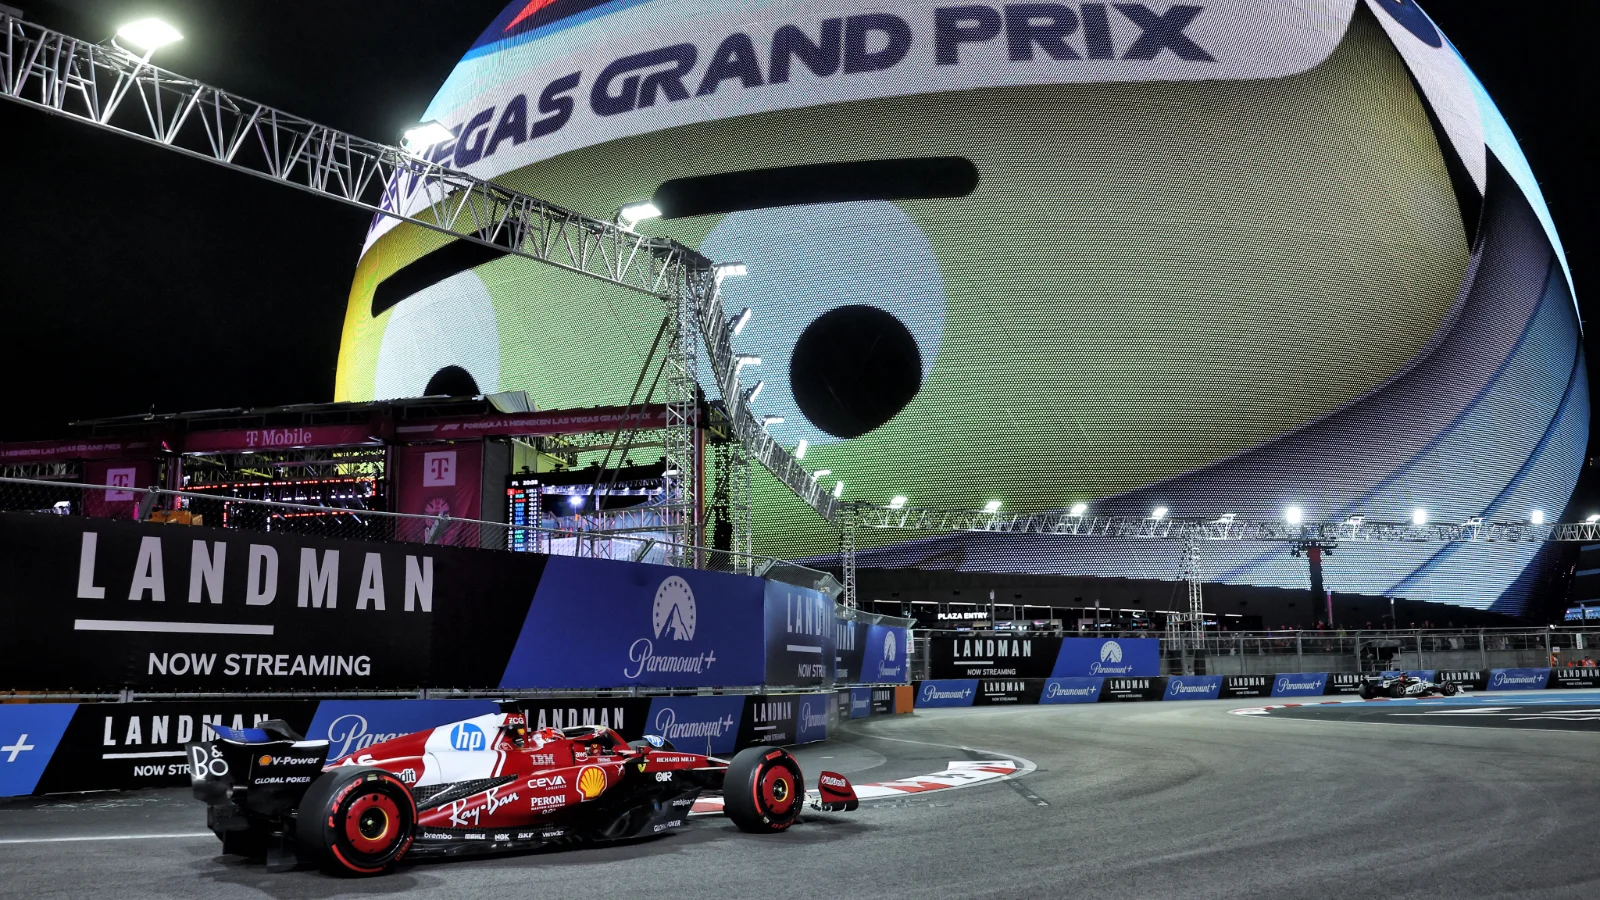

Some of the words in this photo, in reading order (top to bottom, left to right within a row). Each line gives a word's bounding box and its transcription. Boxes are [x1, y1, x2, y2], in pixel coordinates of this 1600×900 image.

[590, 14, 912, 117] GRAND
[934, 2, 1215, 65] PRIX
[462, 420, 502, 430] FORMULA
[552, 416, 570, 425] LAS
[570, 415, 599, 424] VEGAS
[262, 428, 312, 446] Mobile
[76, 531, 435, 613] LANDMAN
[937, 612, 963, 620] PLAZA
[963, 611, 988, 619] ENTRY
[953, 639, 1032, 658] LANDMAN
[148, 652, 217, 676] NOW
[223, 653, 371, 676] STREAMING
[623, 638, 717, 679] Paramount+
[967, 668, 981, 676] NOW
[982, 667, 1017, 676] STREAMING
[1088, 661, 1133, 676] Paramount+
[1440, 671, 1481, 681] LANDMAN
[1557, 669, 1600, 678] LANDMAN
[984, 681, 1026, 692] LANDMAN
[1110, 679, 1150, 690] LANDMAN
[1228, 677, 1266, 687] LANDMAN
[1277, 677, 1322, 693] Paramount+
[1493, 672, 1545, 686] Paramount+
[922, 684, 972, 702] Paramount+
[1046, 682, 1097, 699] Paramount+
[1170, 680, 1218, 696] Paramount+
[753, 701, 792, 722] LANDMAN
[524, 707, 624, 732] LANDMAN
[655, 707, 734, 739] Paramount+
[455, 723, 483, 751] hp
[272, 755, 320, 766] V-Power
[530, 753, 556, 766] IBM
[134, 765, 166, 777] NOW
[285, 776, 311, 784] POKER
[531, 794, 566, 807] PERONI
[424, 831, 453, 840] brembo
